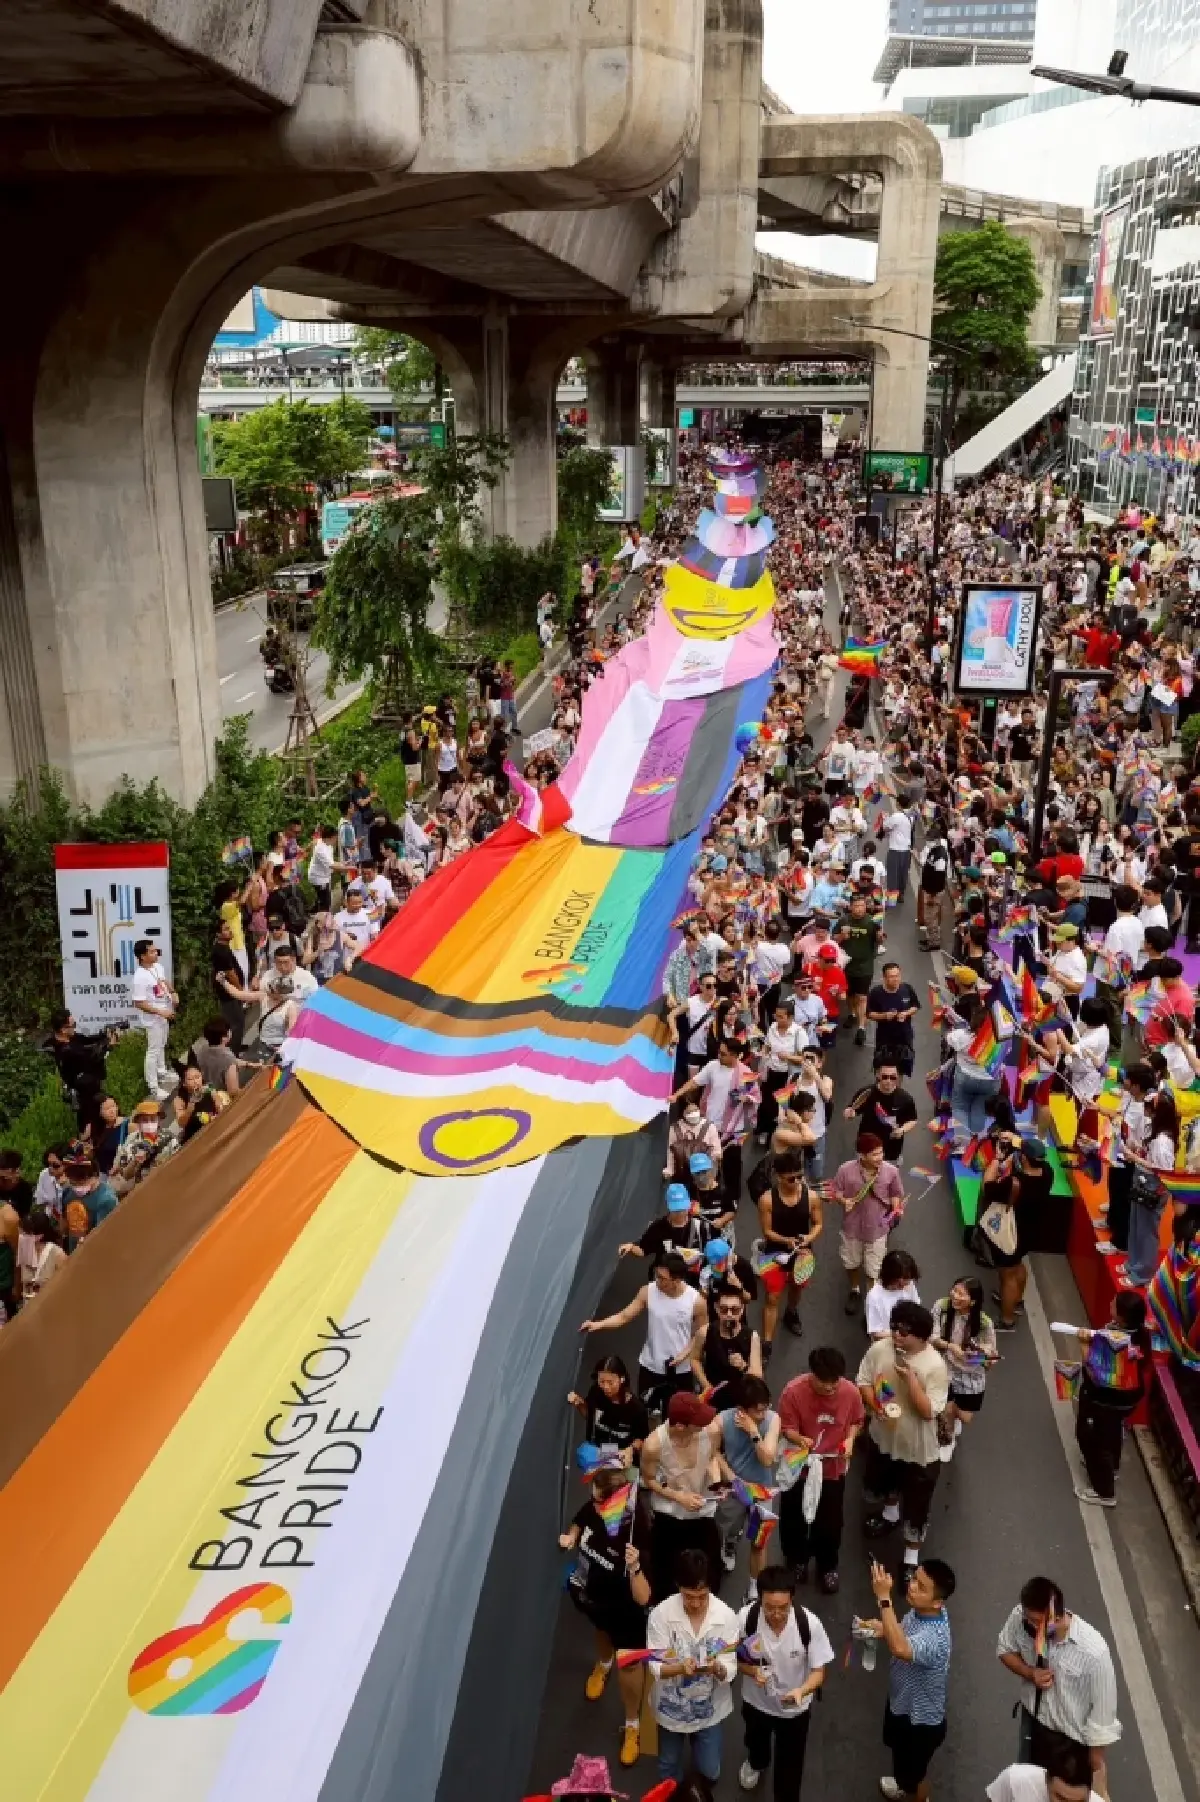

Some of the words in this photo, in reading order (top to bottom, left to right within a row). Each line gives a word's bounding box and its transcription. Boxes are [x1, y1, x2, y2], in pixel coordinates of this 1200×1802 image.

[1020, 595, 1034, 624] DOLL
[1015, 628, 1029, 668] CATHY
[535, 890, 596, 960] BANGKOK
[188, 1315, 370, 1570] BANGKOK
[260, 1405, 385, 1568] PRIDE
